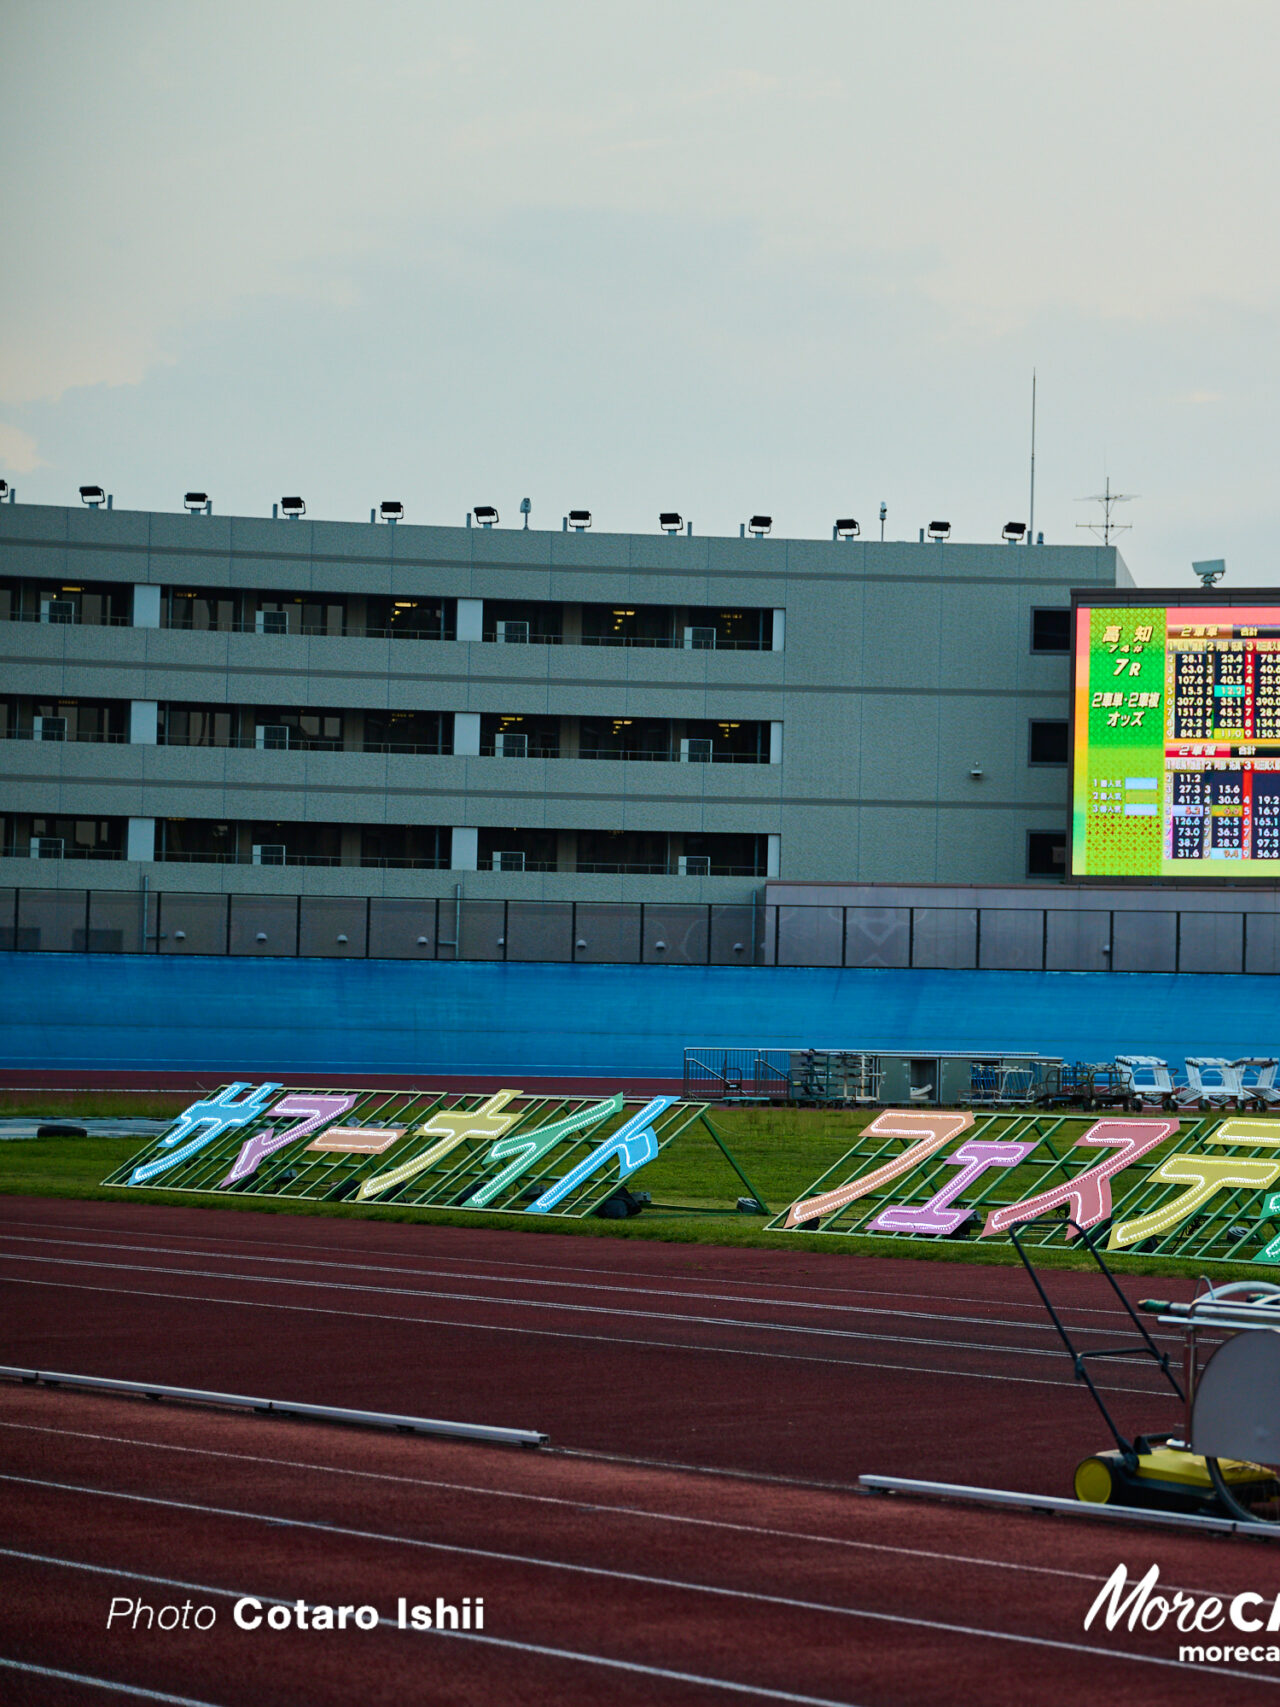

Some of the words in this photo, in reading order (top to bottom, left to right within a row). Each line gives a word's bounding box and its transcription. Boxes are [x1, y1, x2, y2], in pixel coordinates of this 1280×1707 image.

[1102, 624, 1154, 643] 高知
[1182, 655, 1202, 663] 28.1
[1221, 654, 1242, 663] 23.4
[1181, 665, 1203, 674] 63.0
[1221, 665, 1242, 673] 21.7
[1178, 676, 1203, 684] 107.6
[1220, 676, 1242, 684] 40.5
[1183, 687, 1202, 695] 15.5
[1177, 697, 1203, 706] 307.0
[1221, 697, 1240, 705] 35.1
[1178, 708, 1202, 716] 151.8
[1220, 708, 1241, 716] 45.3
[1260, 708, 1280, 716] 28.4
[1107, 711, 1145, 727] オッズ
[1181, 719, 1202, 727] 73.2
[1220, 719, 1241, 727] 65.2
[1257, 719, 1280, 727] 134.8
[1180, 729, 1202, 738] 84.8
[1256, 729, 1280, 738] 150.3
[1180, 774, 1200, 782] 11.2
[1179, 785, 1200, 793] 27.3
[1219, 785, 1240, 793] 15.6
[1178, 796, 1200, 804] 41.2
[1219, 796, 1240, 804] 30.6
[1175, 817, 1199, 825] 126.6
[1218, 817, 1238, 825] 36.5
[1179, 828, 1199, 836] 73.0
[1218, 828, 1238, 836] 36.5
[1178, 839, 1198, 847] 38.7
[1217, 839, 1239, 847] 28.9
[1178, 849, 1199, 858] 31.6
[127, 1081, 681, 1213] サマーナイト
